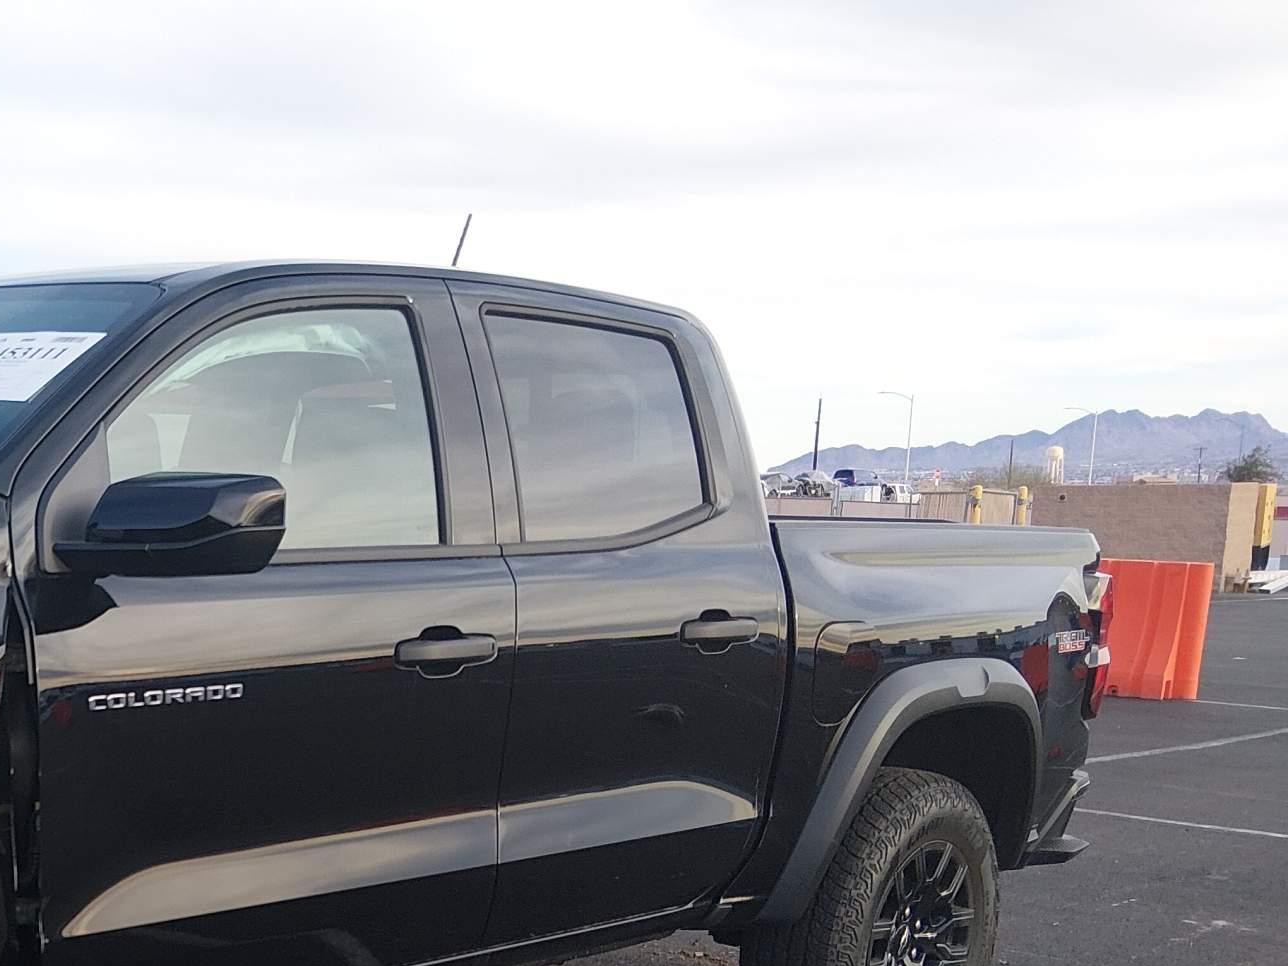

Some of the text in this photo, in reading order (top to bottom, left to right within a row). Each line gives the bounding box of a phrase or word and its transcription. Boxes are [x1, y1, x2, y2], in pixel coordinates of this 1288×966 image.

[1056, 629, 1090, 643] TRAIL
[1058, 640, 1086, 653] BOSS
[87, 683, 244, 711] COLORADO
